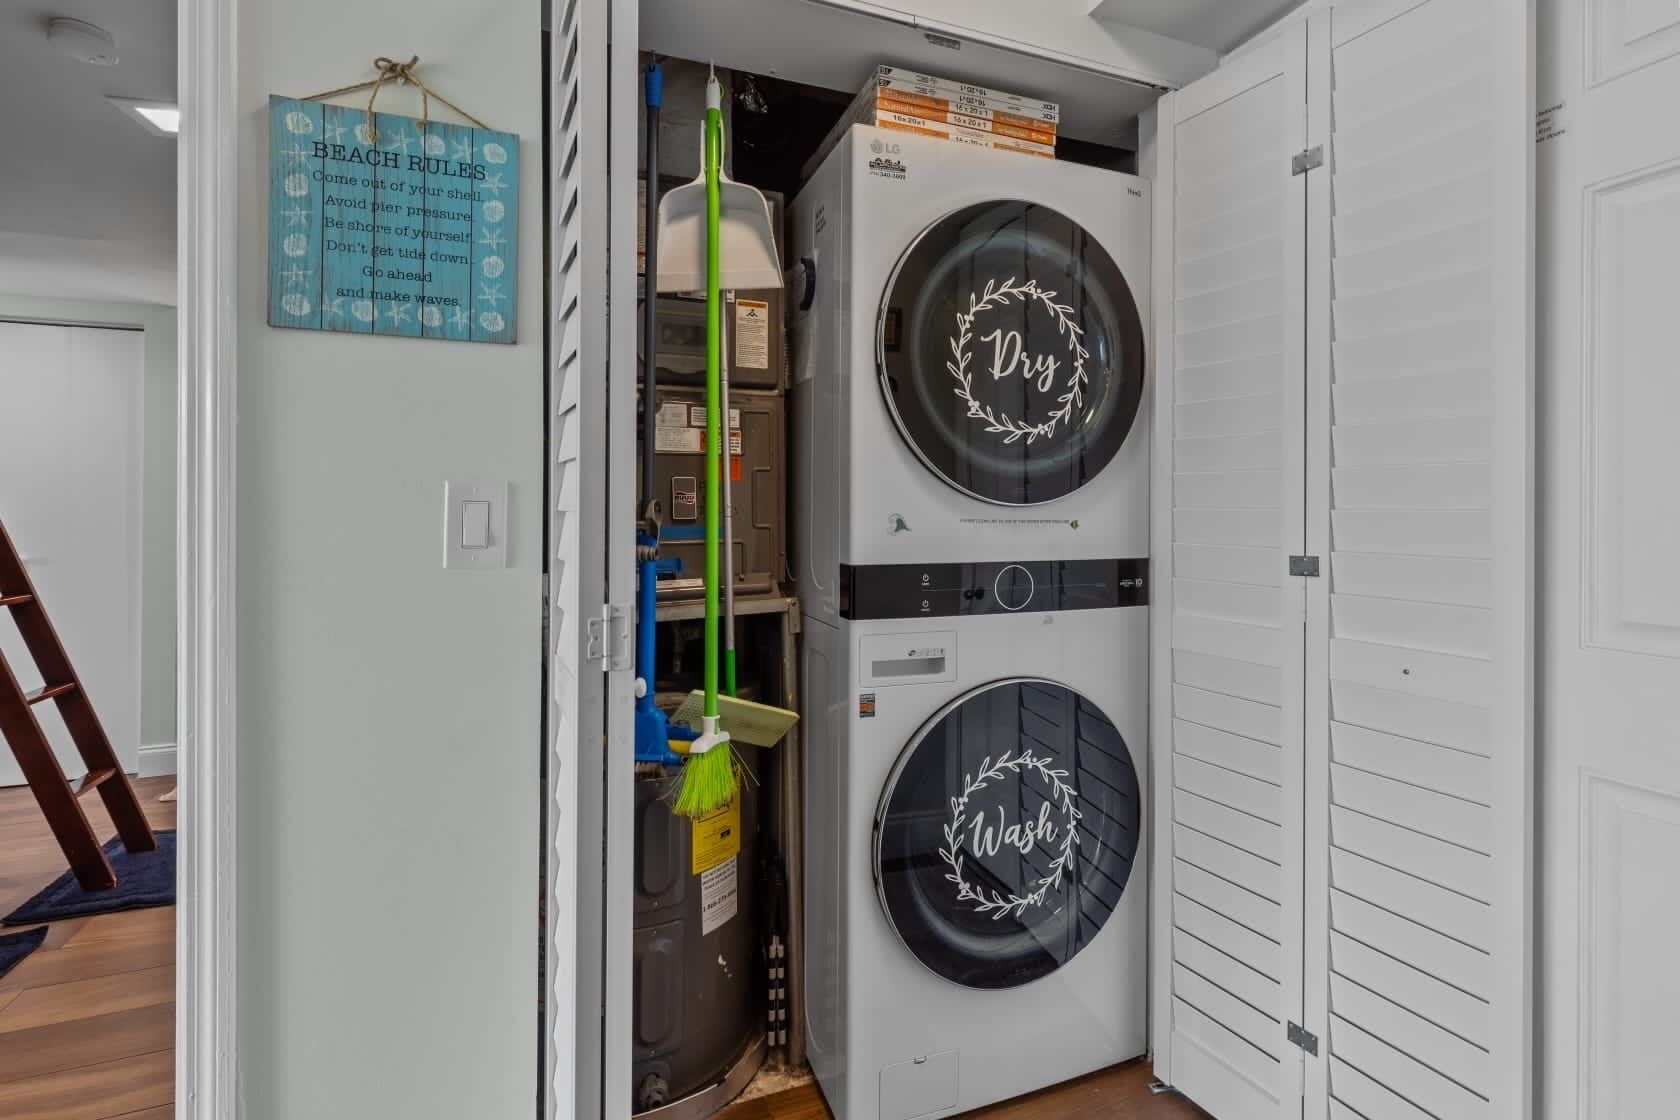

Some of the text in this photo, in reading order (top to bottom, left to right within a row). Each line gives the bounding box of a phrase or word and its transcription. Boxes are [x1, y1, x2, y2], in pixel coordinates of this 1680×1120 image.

[885, 143, 900, 153] LG
[312, 141, 486, 181] BEACH RULES
[312, 170, 357, 186] Come
[361, 177, 386, 190] out
[390, 180, 404, 191] of
[408, 184, 444, 196] your
[325, 194, 367, 210] Avoid
[371, 200, 401, 214] pier
[324, 217, 344, 229] Be
[347, 219, 392, 234] shore
[394, 225, 409, 236] of
[326, 239, 368, 254] Don't
[371, 244, 394, 258] get
[399, 247, 426, 260] tide
[362, 265, 432, 282] Go ahead
[336, 287, 364, 298] and
[370, 290, 410, 303] make
[980, 328, 1061, 392] Dry
[968, 801, 1059, 858] Wash
